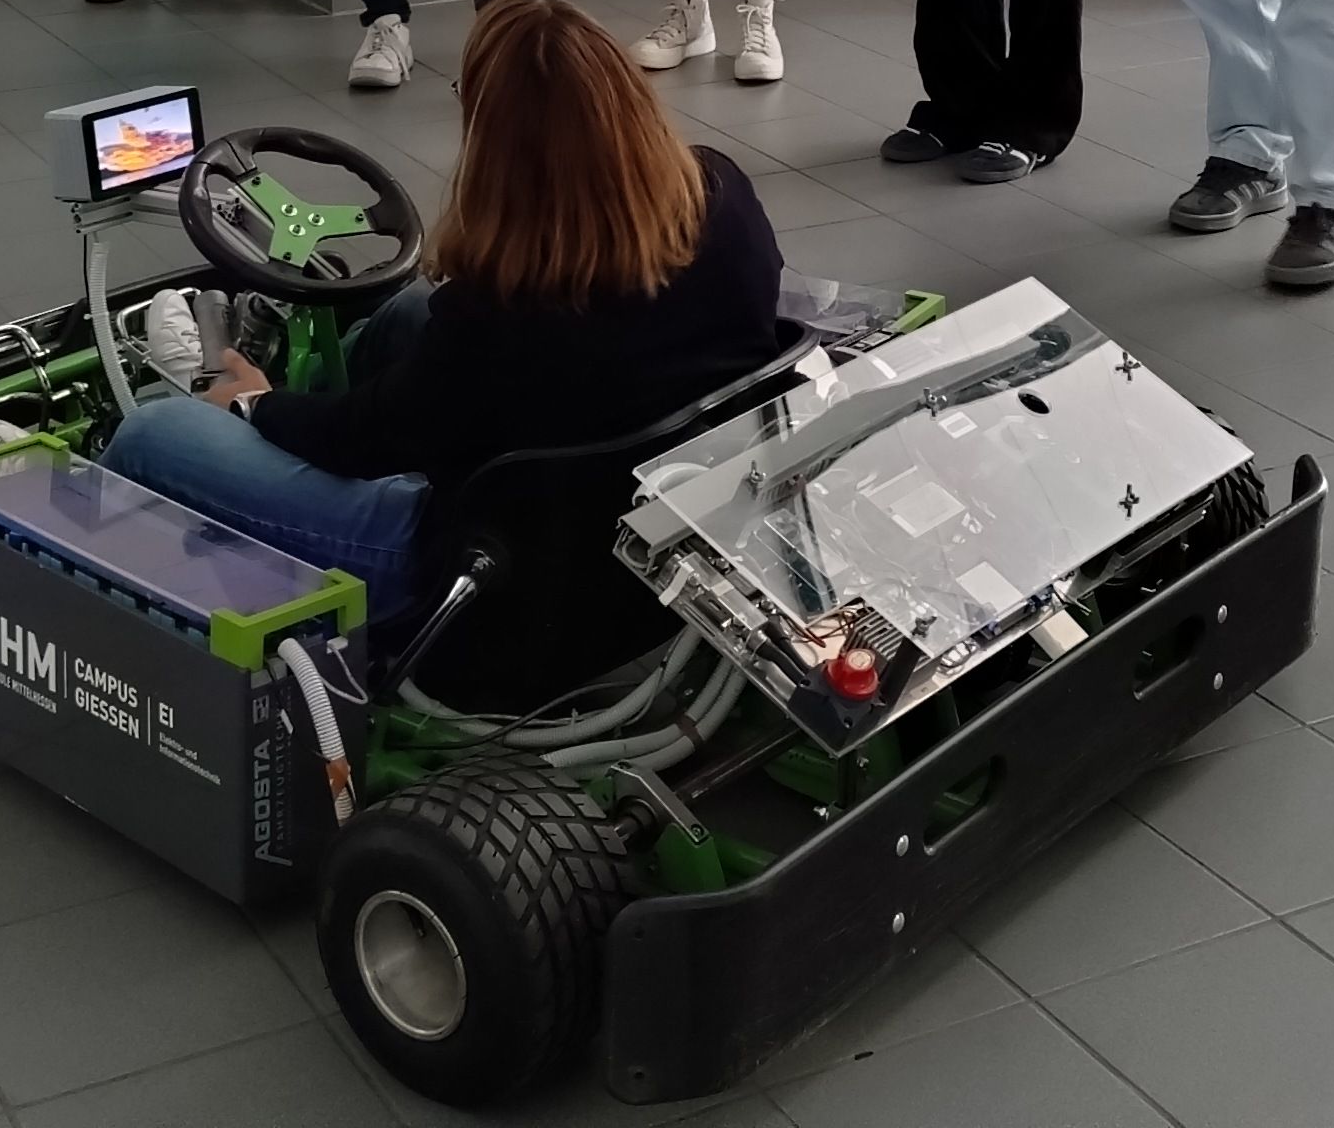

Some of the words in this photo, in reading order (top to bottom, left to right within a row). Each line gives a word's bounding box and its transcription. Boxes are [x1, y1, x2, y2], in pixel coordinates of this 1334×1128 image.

[12, 678, 57, 713] MITTELHESSEN
[74, 657, 139, 708] CAMPUS
[75, 687, 140, 740] GIESSEN
[158, 702, 174, 729] EI
[159, 743, 221, 786] Informationstechnik
[184, 748, 198, 761] und
[253, 738, 293, 867] AGOSTA
